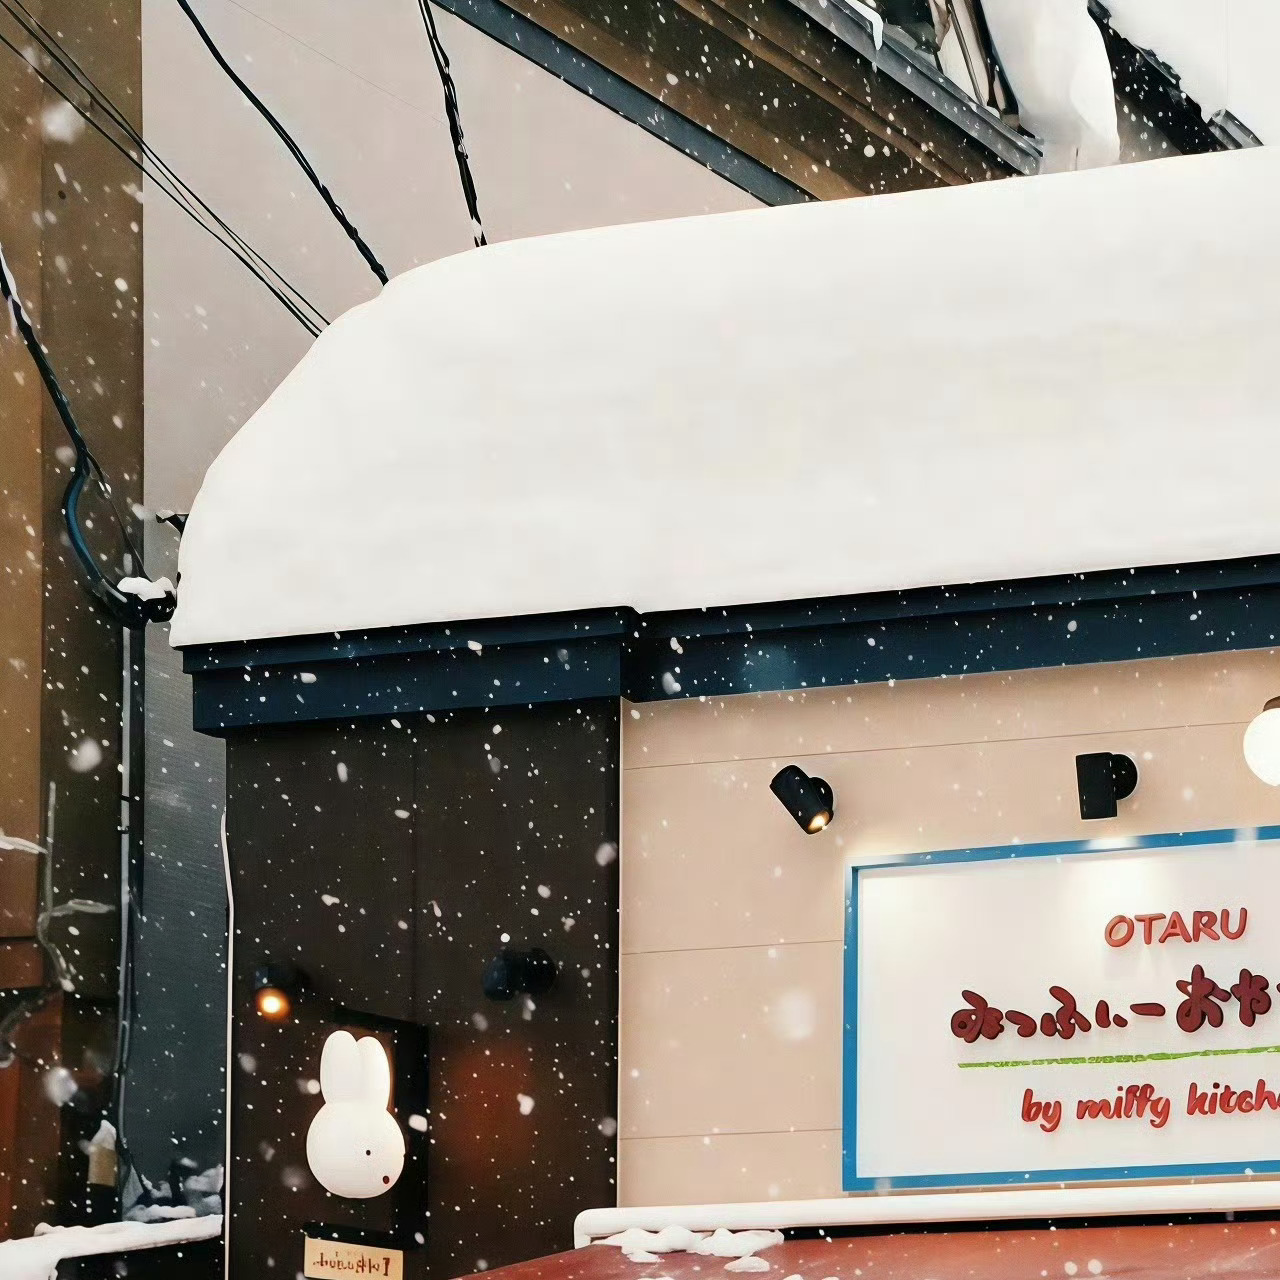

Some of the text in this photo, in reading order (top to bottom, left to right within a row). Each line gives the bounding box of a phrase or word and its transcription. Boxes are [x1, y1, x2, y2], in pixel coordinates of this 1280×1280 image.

[1104, 907, 1248, 948] OTARU
[1021, 1088, 1063, 1133] by
[1076, 1083, 1171, 1129] miffy
